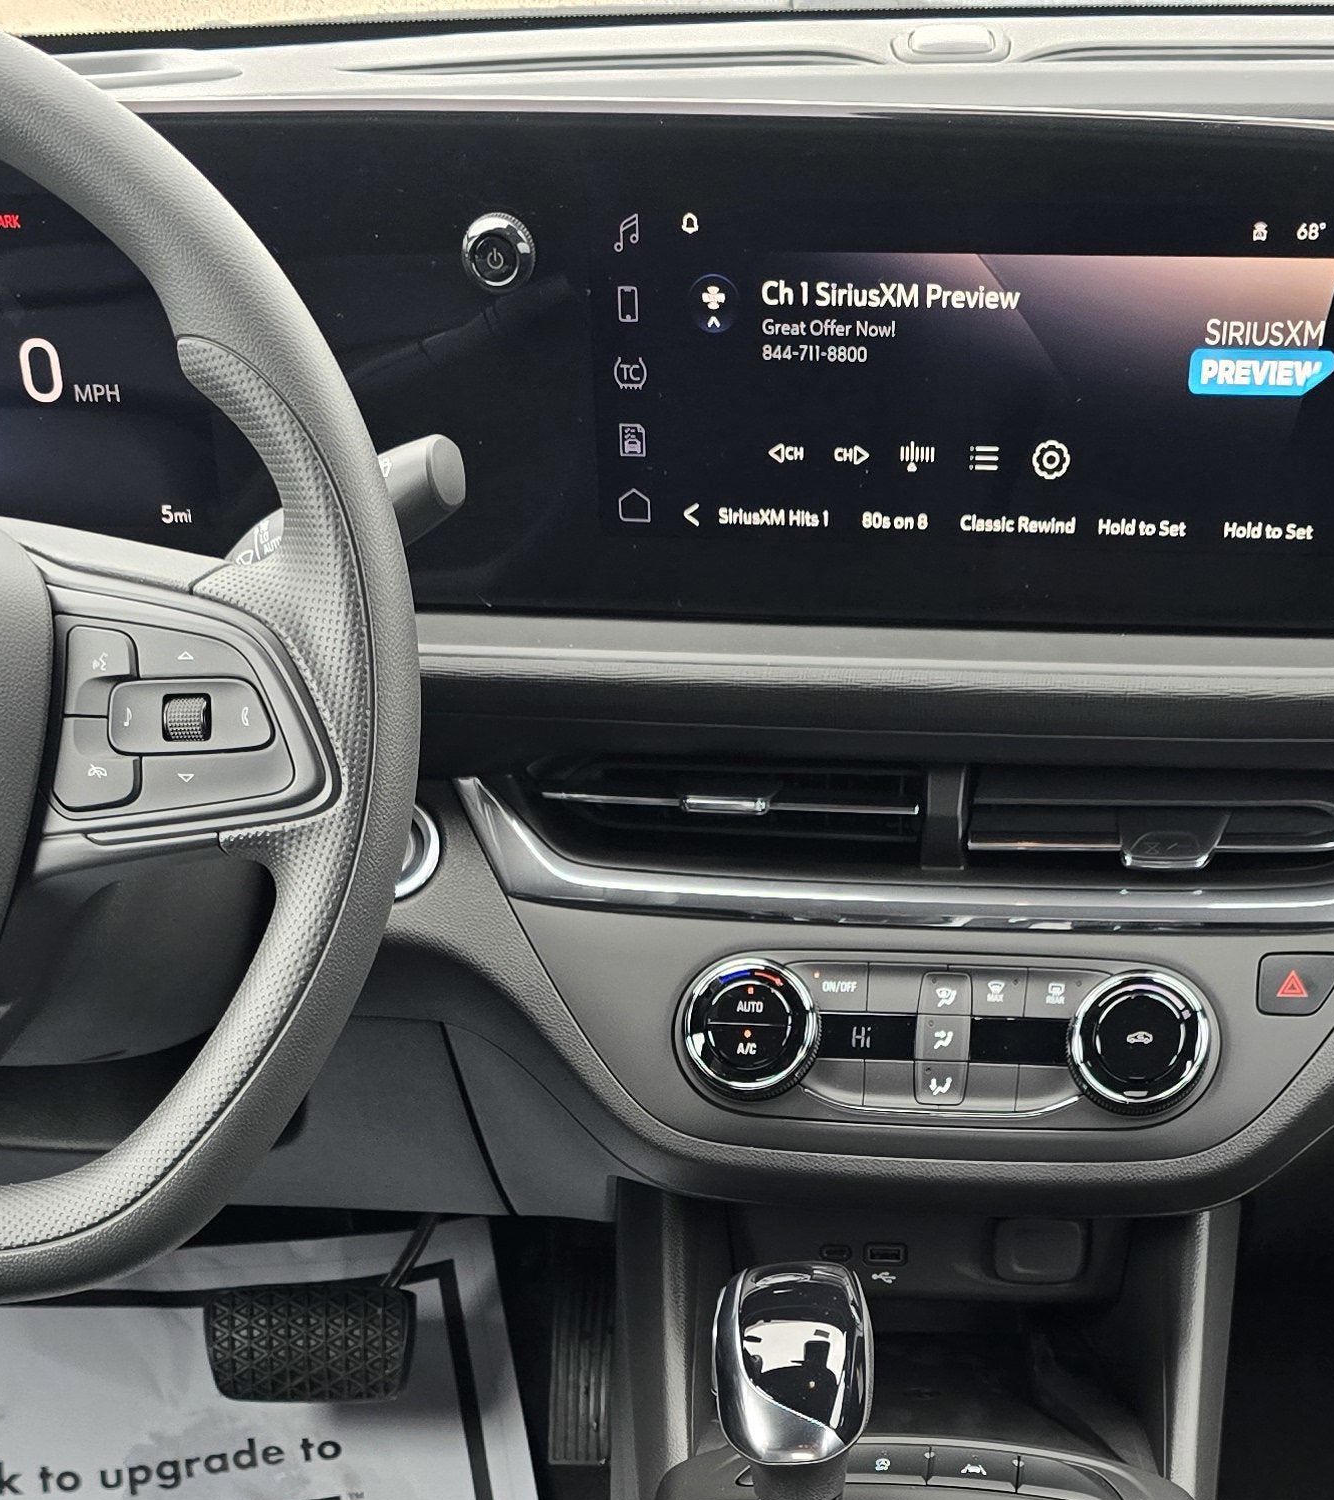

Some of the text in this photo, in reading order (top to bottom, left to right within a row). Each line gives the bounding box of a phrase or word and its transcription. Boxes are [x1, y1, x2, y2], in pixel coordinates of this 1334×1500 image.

[761, 280, 1021, 309] Ch 1 SiriusXM Preview
[761, 319, 896, 337] Great Offer Now!
[1205, 318, 1326, 347] SIRIUSXM
[762, 344, 868, 362] 844-711-8800
[19, 337, 121, 403] 0 MPH
[1200, 359, 1323, 386] PREVIEW
[785, 446, 804, 461] CH
[833, 447, 853, 462] CH
[718, 507, 829, 527] SiriusXM Hits 1
[862, 511, 929, 530] 80s on 8
[960, 514, 1077, 534] Classic Rewind
[1098, 518, 1187, 537] Hold to Set
[1223, 521, 1314, 540] Hold to Set
[822, 981, 858, 993] ON/OFF
[736, 1000, 763, 1013] AUTO
[736, 1042, 757, 1055] A/C
[40, 1465, 82, 1493] to
[100, 1437, 285, 1495] upgrade
[300, 1437, 343, 1461] to
